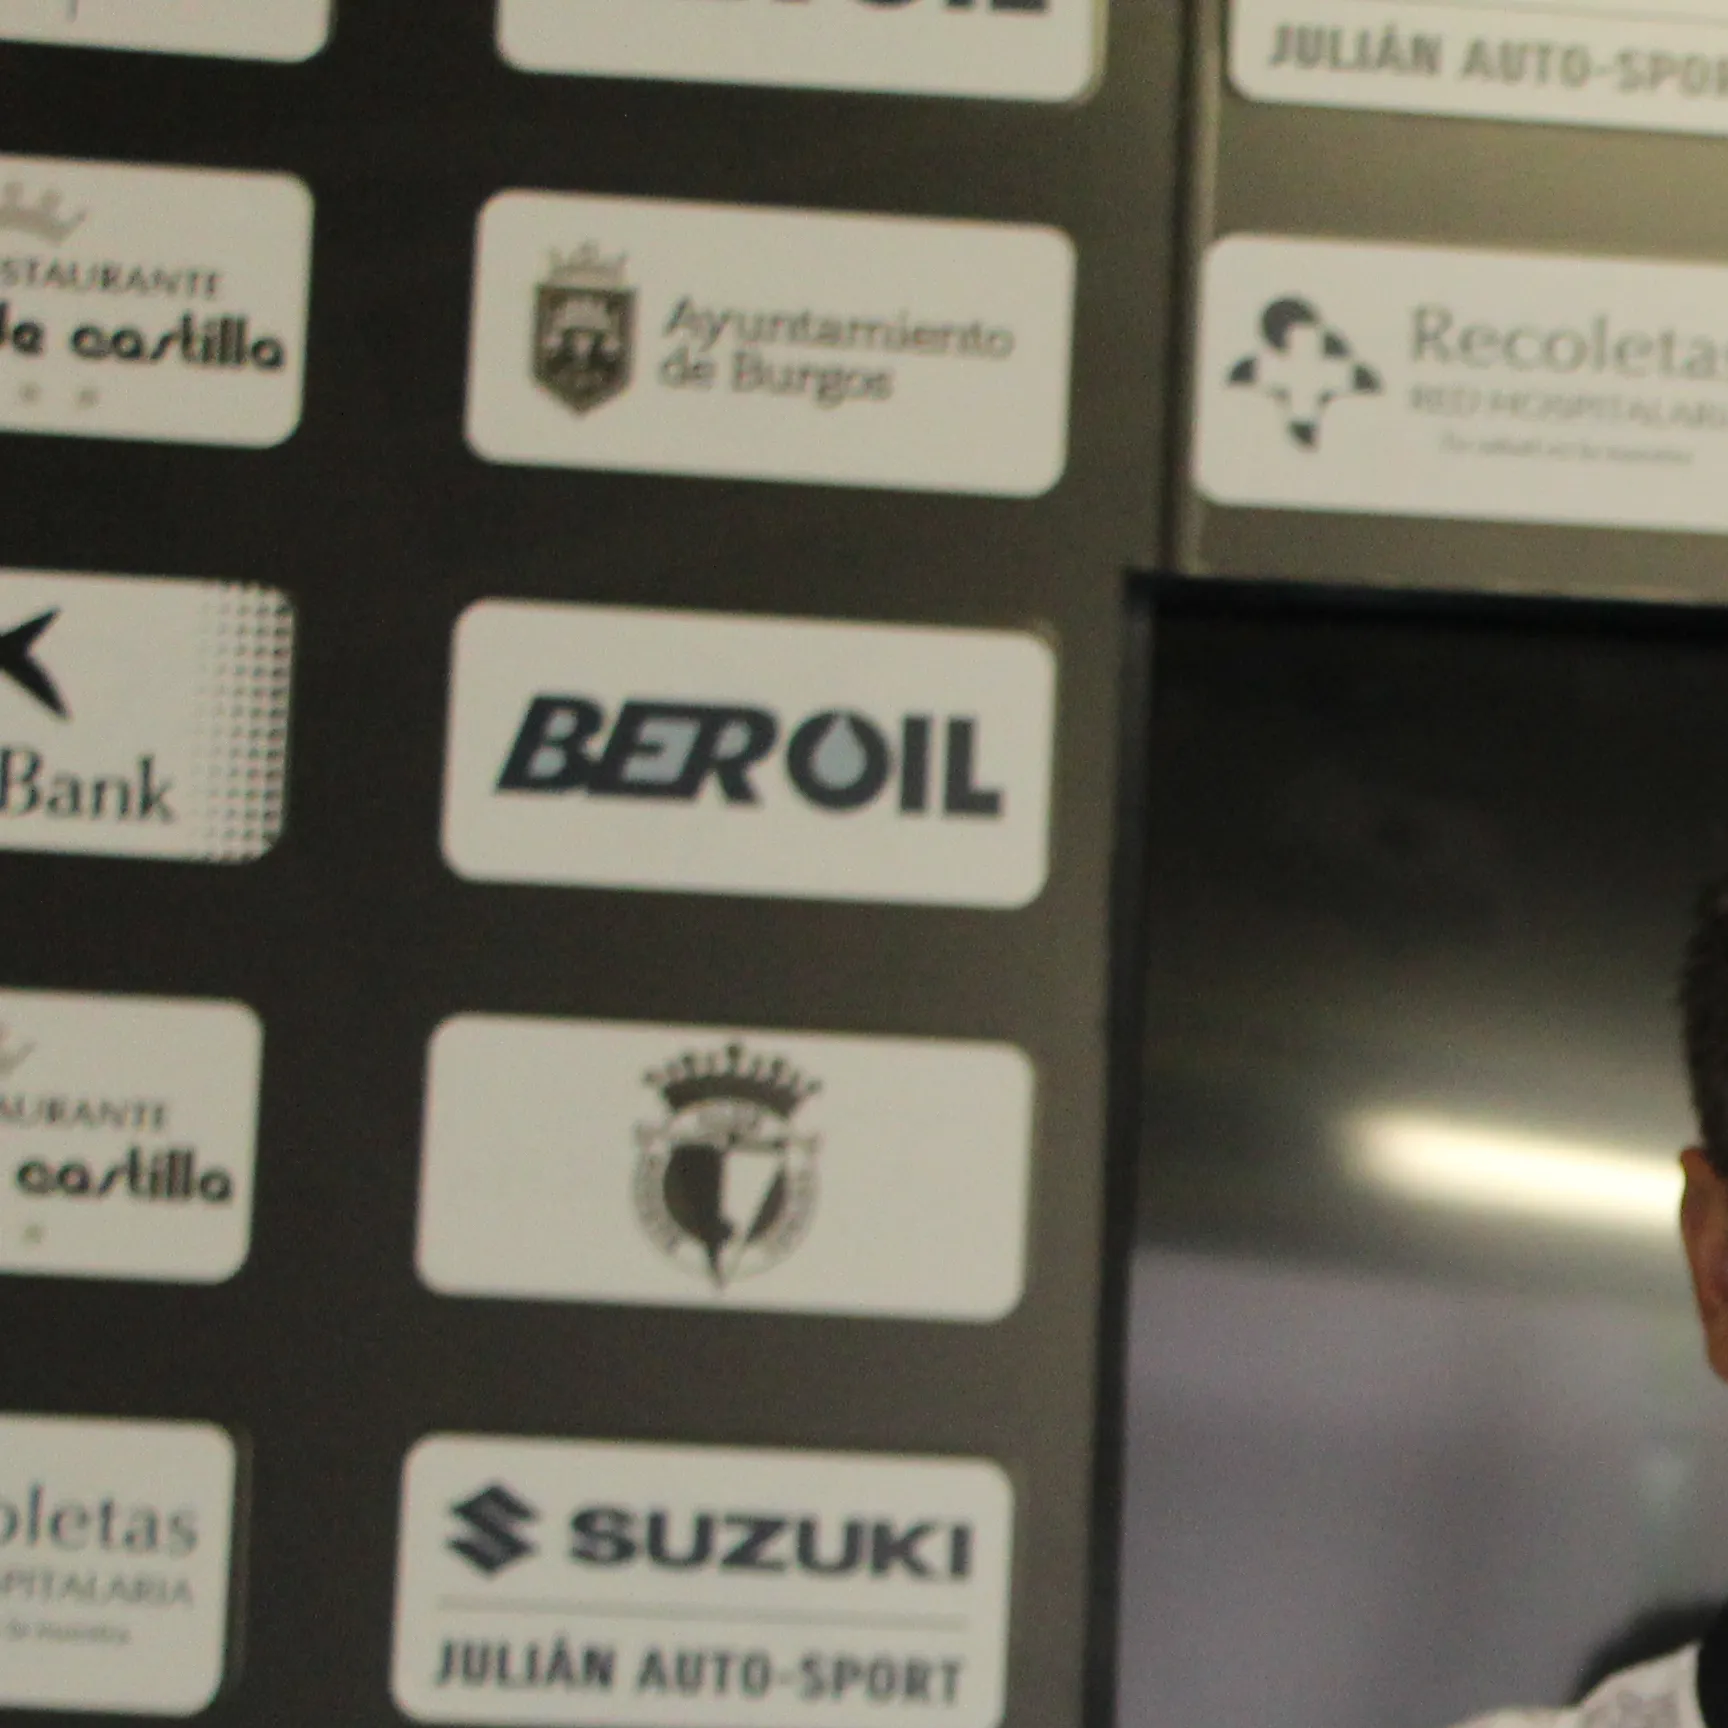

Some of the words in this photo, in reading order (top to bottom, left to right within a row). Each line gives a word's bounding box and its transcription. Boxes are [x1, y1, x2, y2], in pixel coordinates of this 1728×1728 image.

[1269, 20, 1440, 80] JULIÁN
[661, 294, 1015, 362] Ayuntamiento
[659, 349, 716, 392] de
[731, 352, 894, 408] Burgos
[495, 692, 1005, 817] BEROIL
[570, 1508, 974, 1583] SUZUKI
[434, 1632, 615, 1690] JULIÁN
[638, 1646, 964, 1707] AUTO-SPORT
